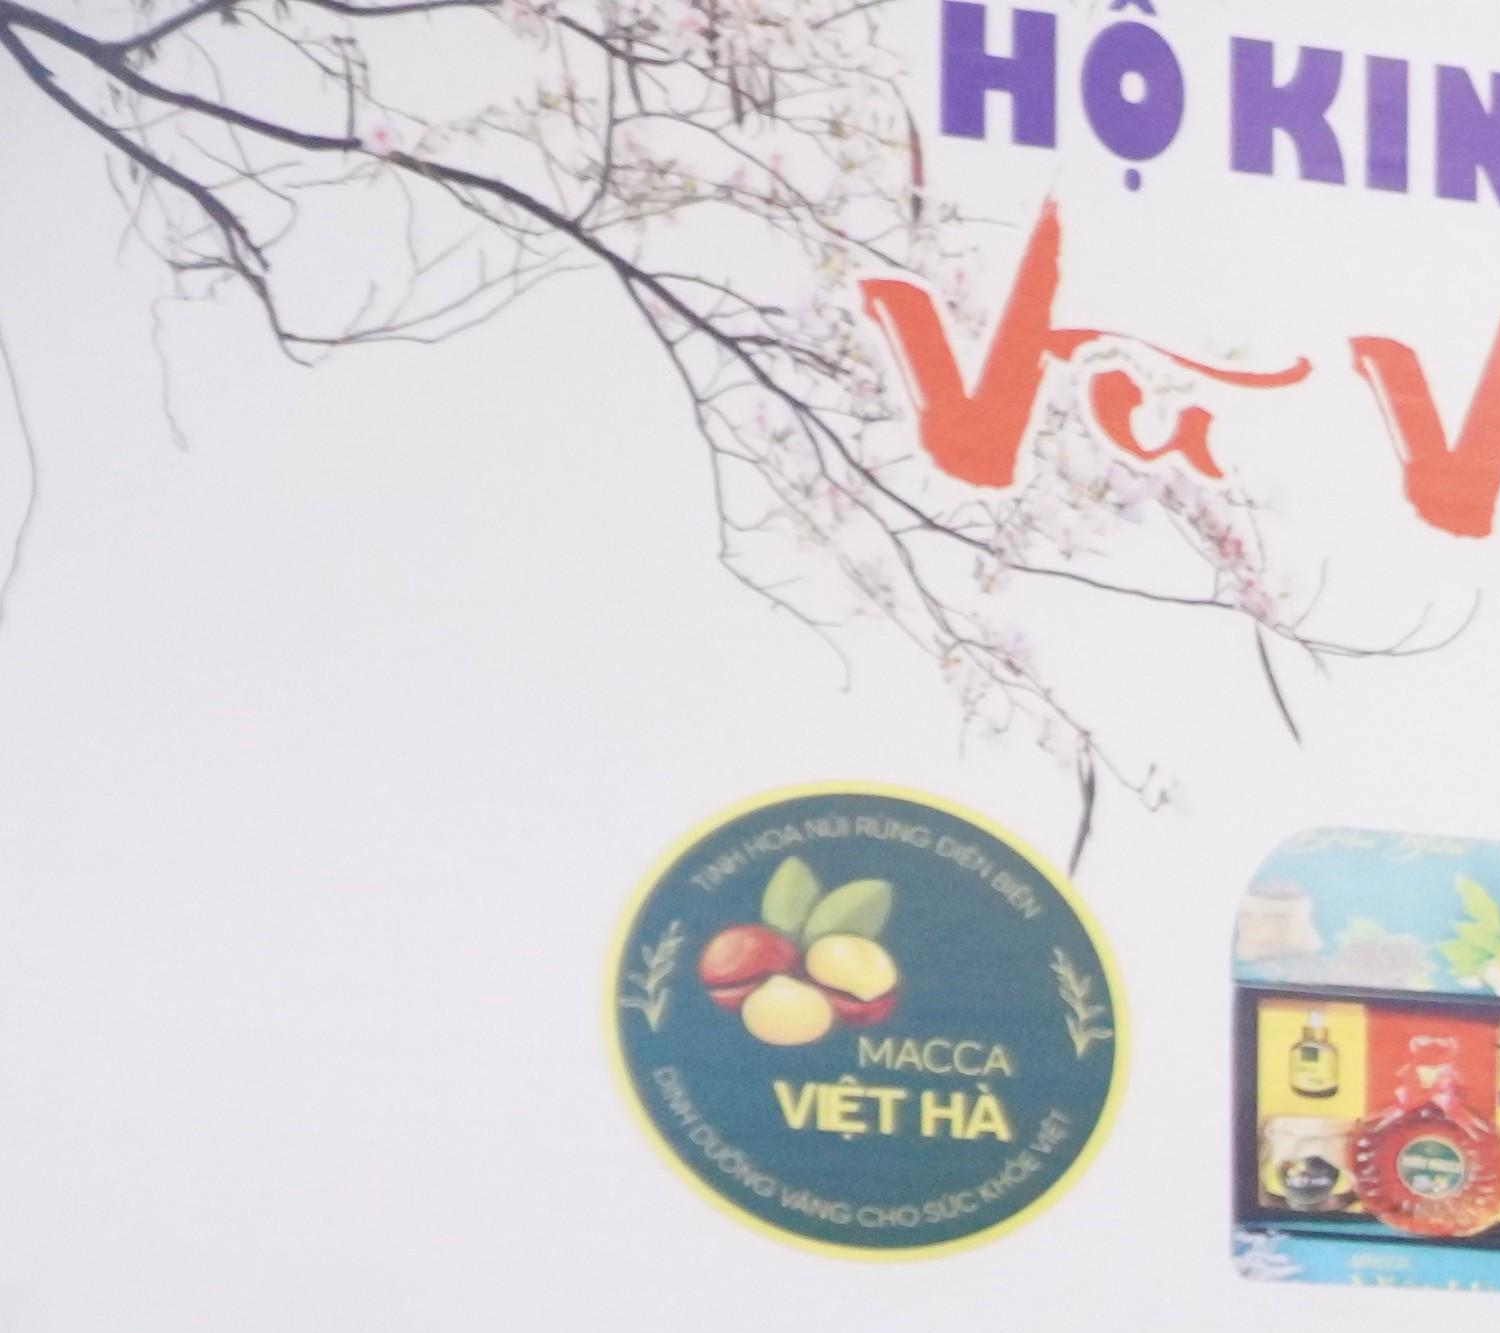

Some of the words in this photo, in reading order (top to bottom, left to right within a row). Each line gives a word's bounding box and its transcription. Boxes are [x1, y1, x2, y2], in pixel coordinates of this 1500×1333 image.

[939, 0, 1185, 193] HỘ
[857, 1035, 1015, 1077] MACCA
[773, 1073, 909, 1142] VIỆT
[920, 1082, 1013, 1143] HÀ
